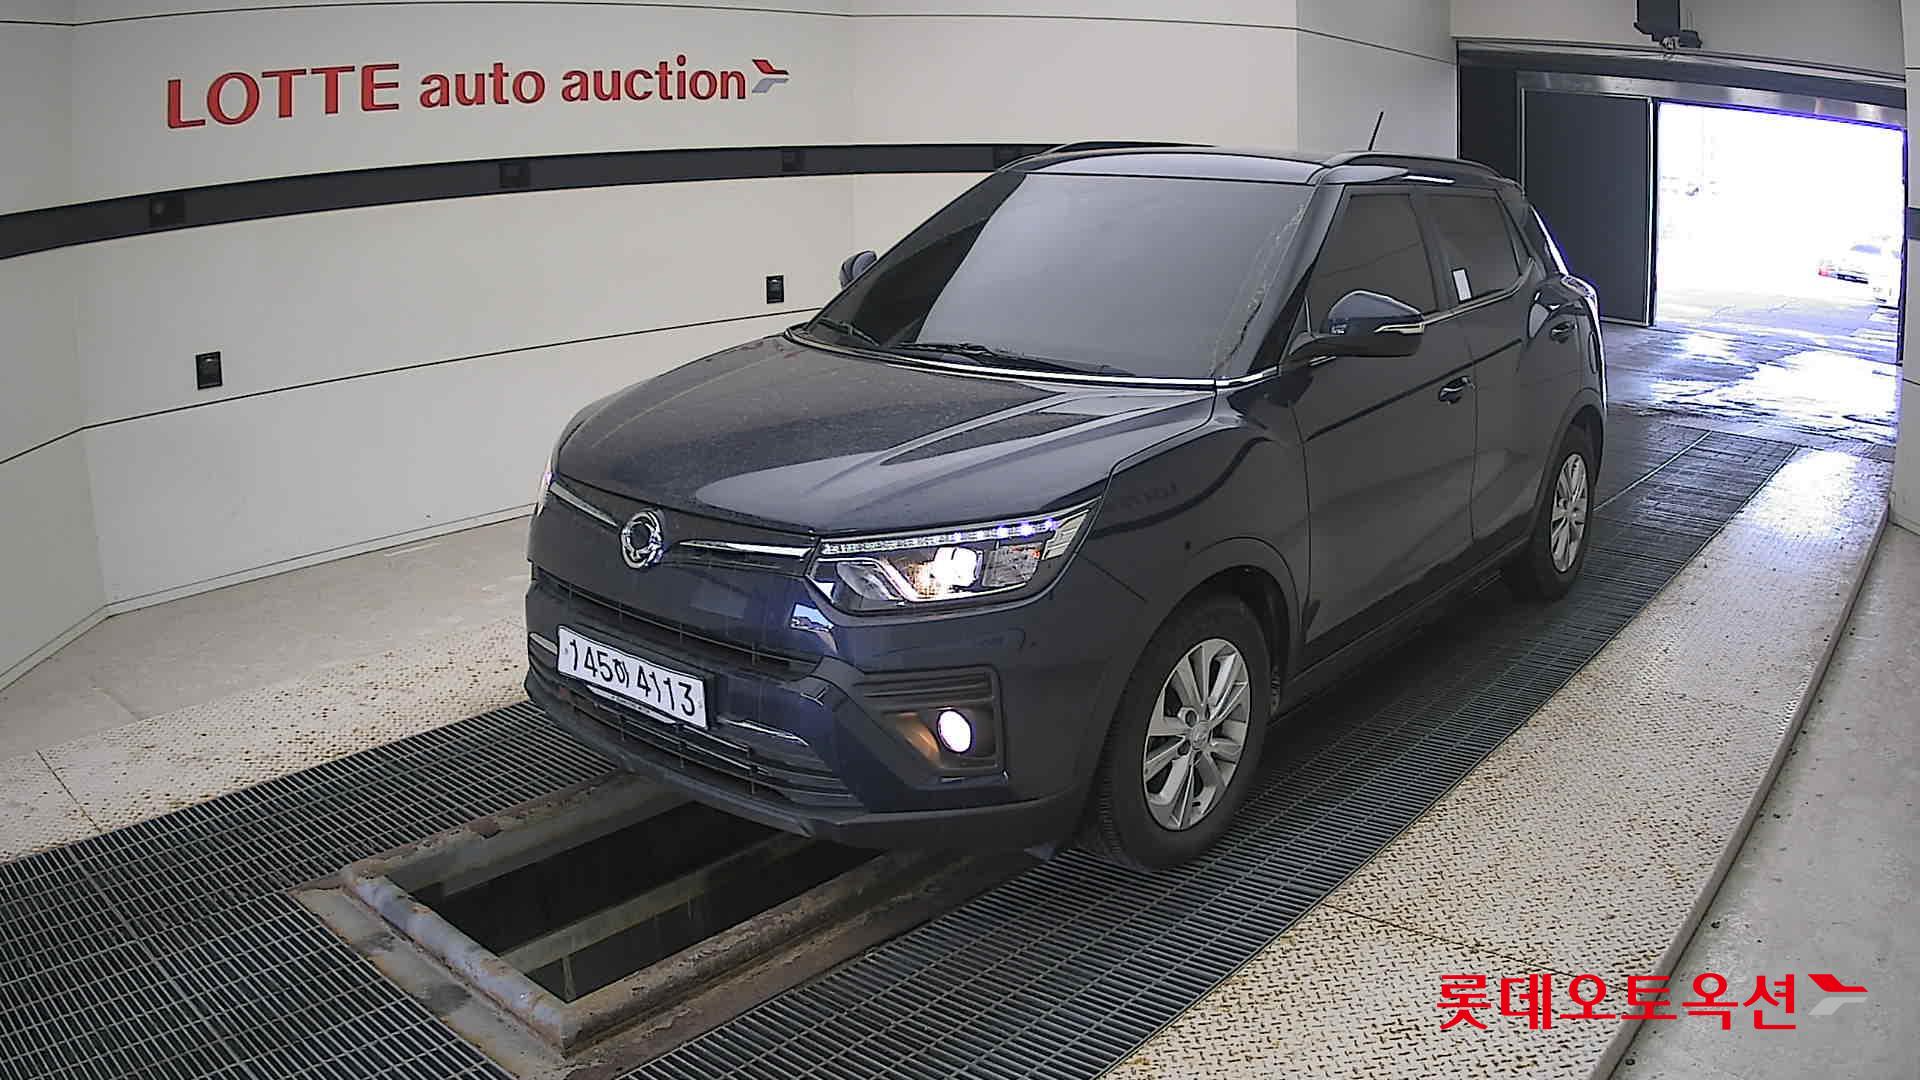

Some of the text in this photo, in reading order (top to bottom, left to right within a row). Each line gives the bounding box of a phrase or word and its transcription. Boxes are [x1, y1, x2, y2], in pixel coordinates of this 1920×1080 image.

[167, 54, 748, 130] LOTTE auto auction
[637, 665, 696, 717] 4113
